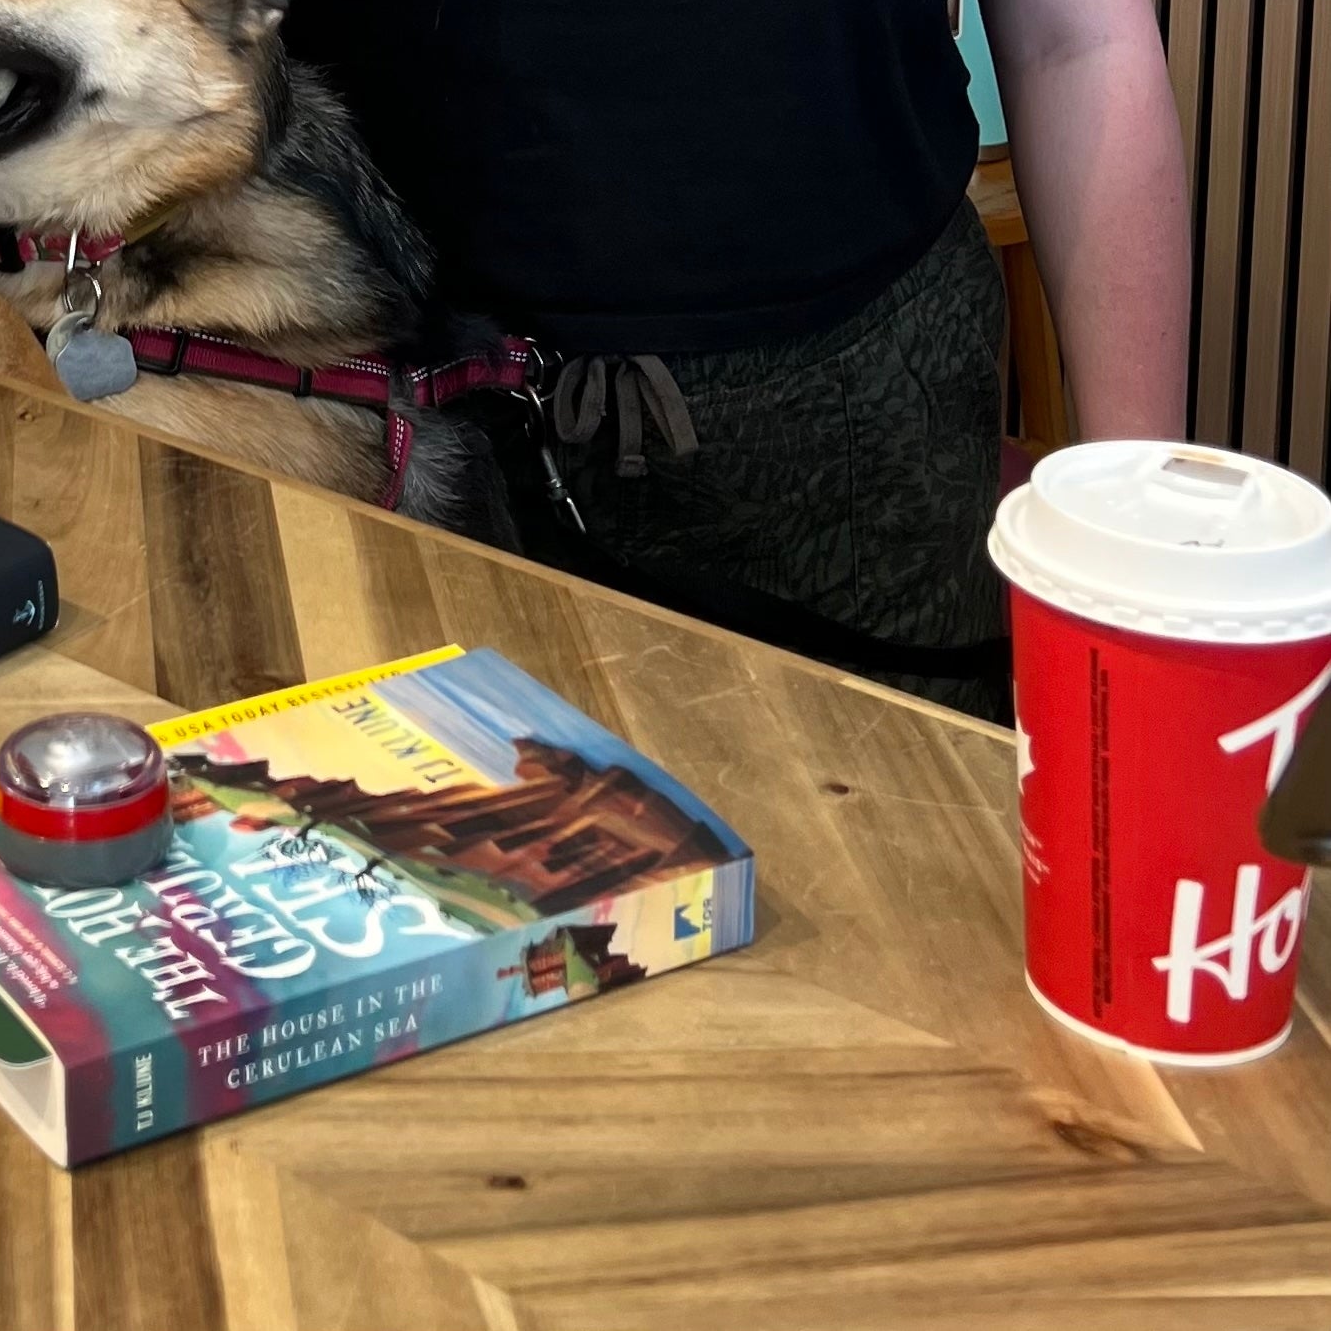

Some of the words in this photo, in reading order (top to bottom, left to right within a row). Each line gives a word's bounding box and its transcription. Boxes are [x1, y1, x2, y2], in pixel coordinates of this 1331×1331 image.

[173, 720, 213, 738] USA
[220, 700, 281, 728] TODAY
[330, 695, 432, 760] KLUNE
[412, 758, 463, 784] TJ
[228, 828, 487, 959] SEA
[115, 936, 229, 1022] THE
[198, 1033, 251, 1068] THE
[262, 1003, 346, 1049] HOUSE
[357, 991, 383, 1019] IN
[394, 973, 444, 1006] THE
[226, 1028, 363, 1090] CERULEAN
[373, 1012, 419, 1044] SEA
[134, 1051, 154, 1109] KLUNE
